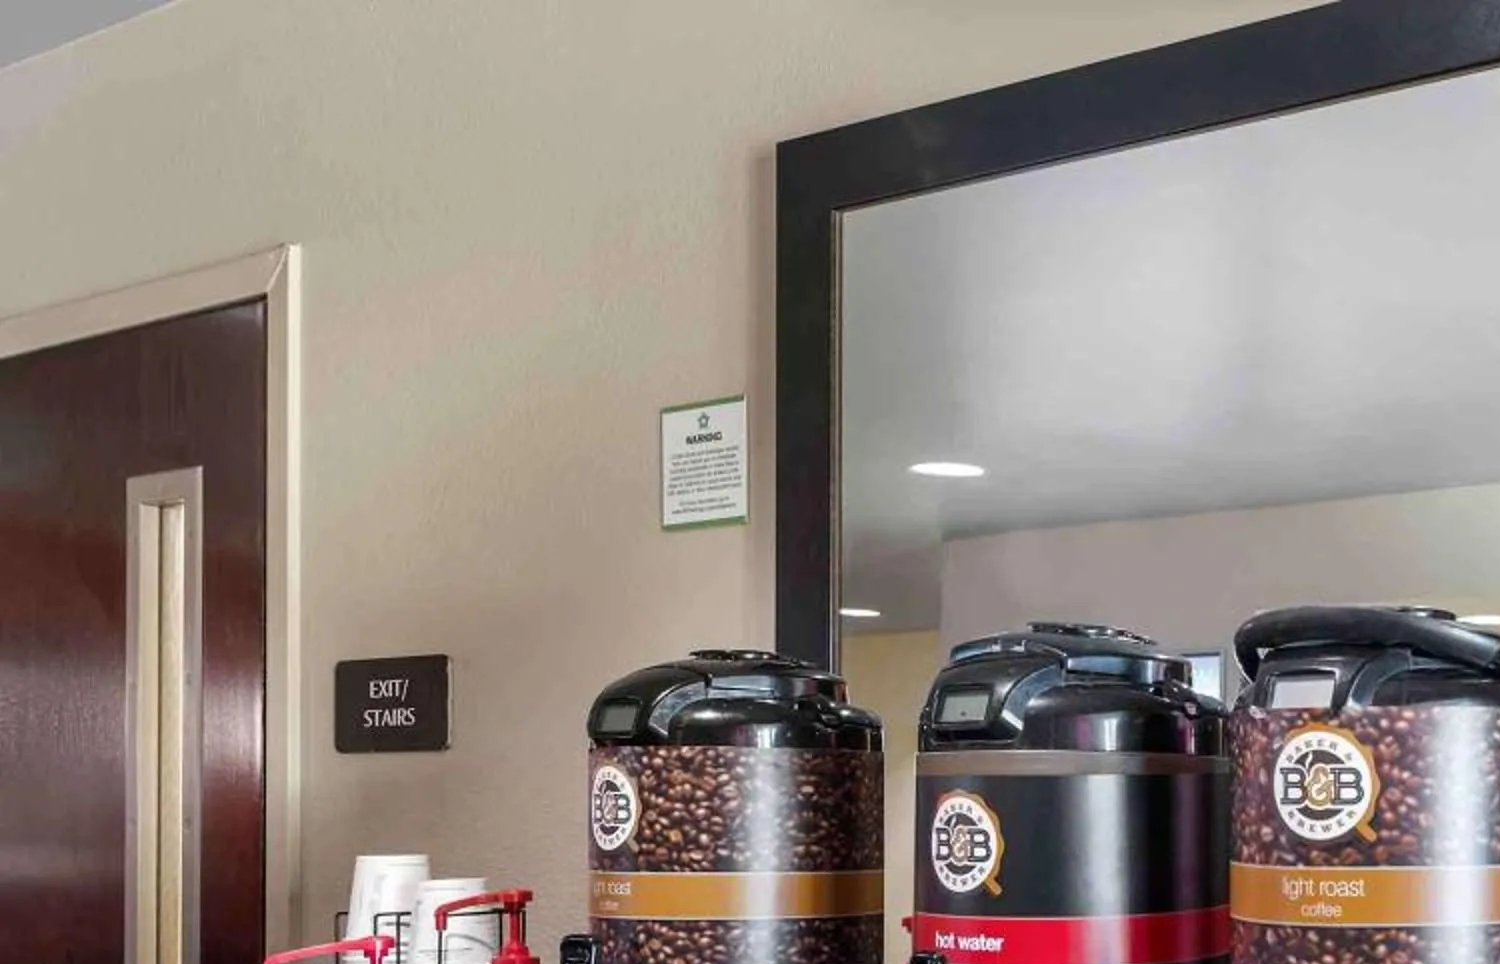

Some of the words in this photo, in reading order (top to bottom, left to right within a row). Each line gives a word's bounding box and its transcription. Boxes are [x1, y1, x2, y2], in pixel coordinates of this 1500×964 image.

[369, 679, 409, 701] EXIT/
[363, 707, 416, 728] STAIRS
[1319, 877, 1366, 897] roast
[1300, 902, 1343, 918] coffee
[935, 930, 955, 949] hot
[957, 933, 1005, 952] water
